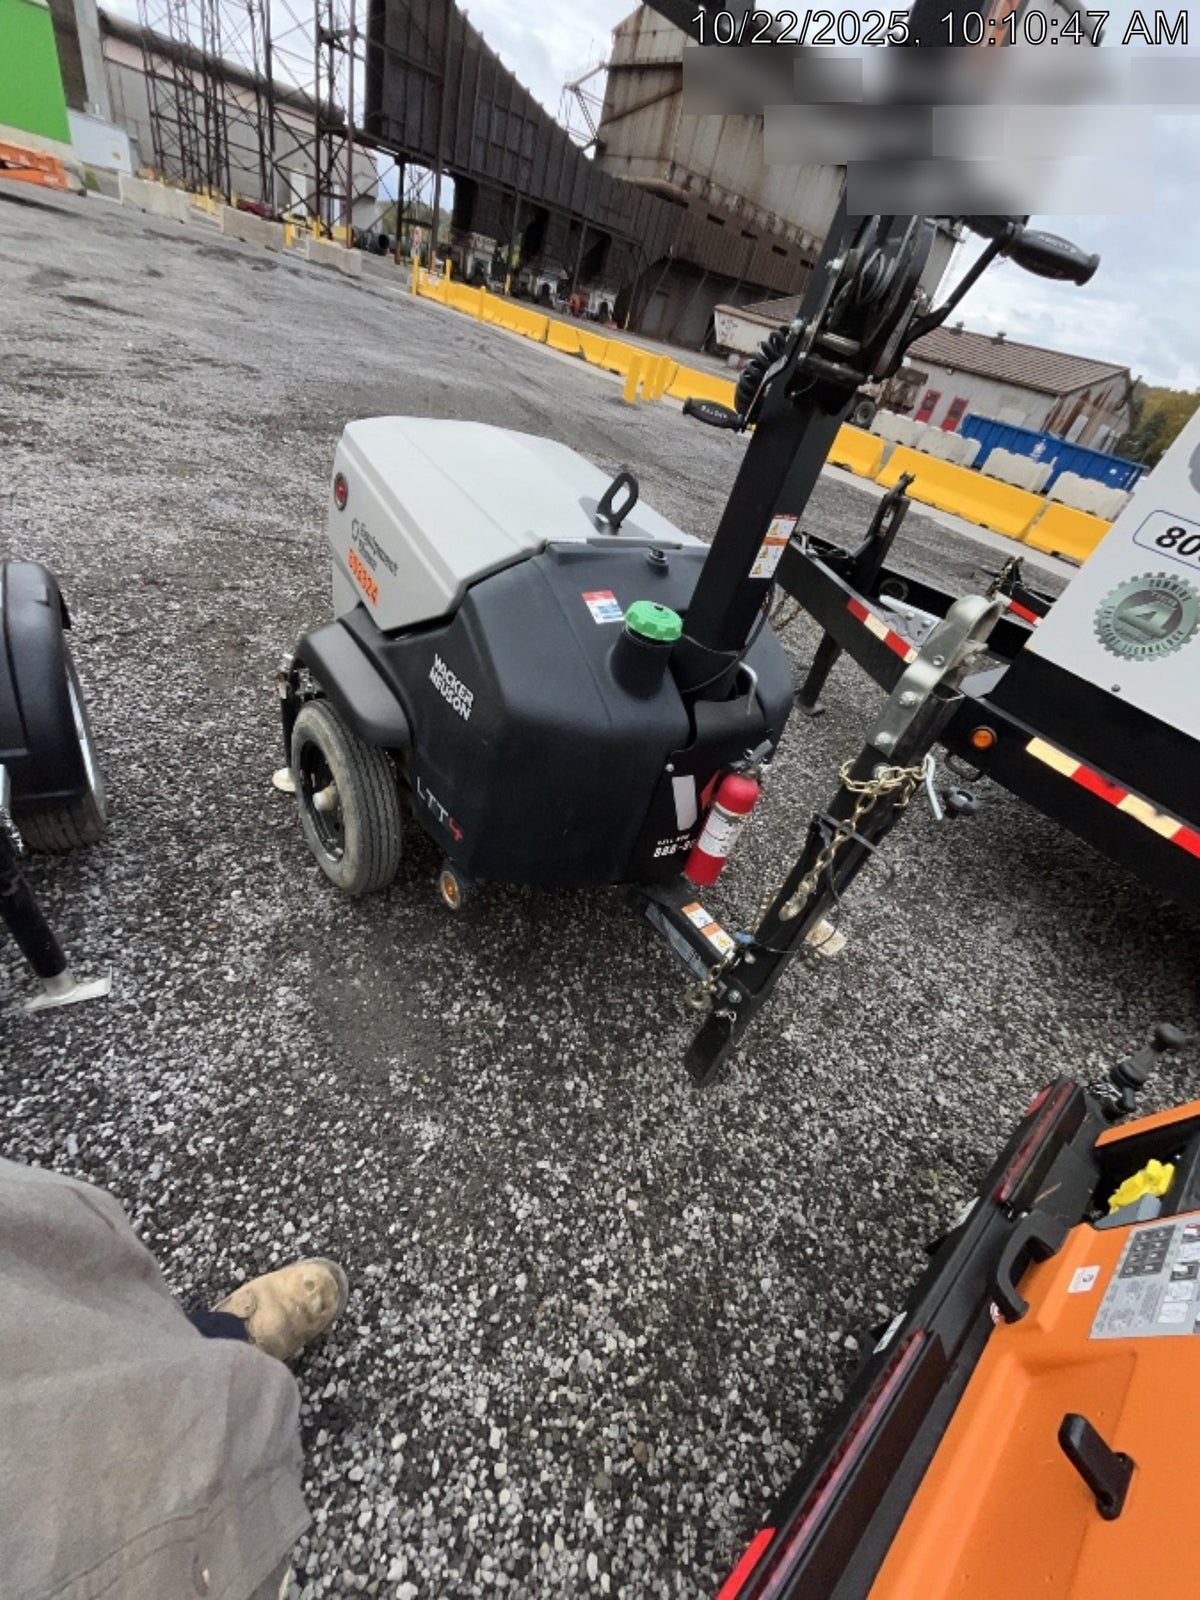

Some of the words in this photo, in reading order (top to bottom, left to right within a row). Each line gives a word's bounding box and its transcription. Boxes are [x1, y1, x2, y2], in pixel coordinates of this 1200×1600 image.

[1155, 526, 1200, 563] 80
[428, 666, 472, 721] NEUSON
[434, 653, 474, 708] WACKER
